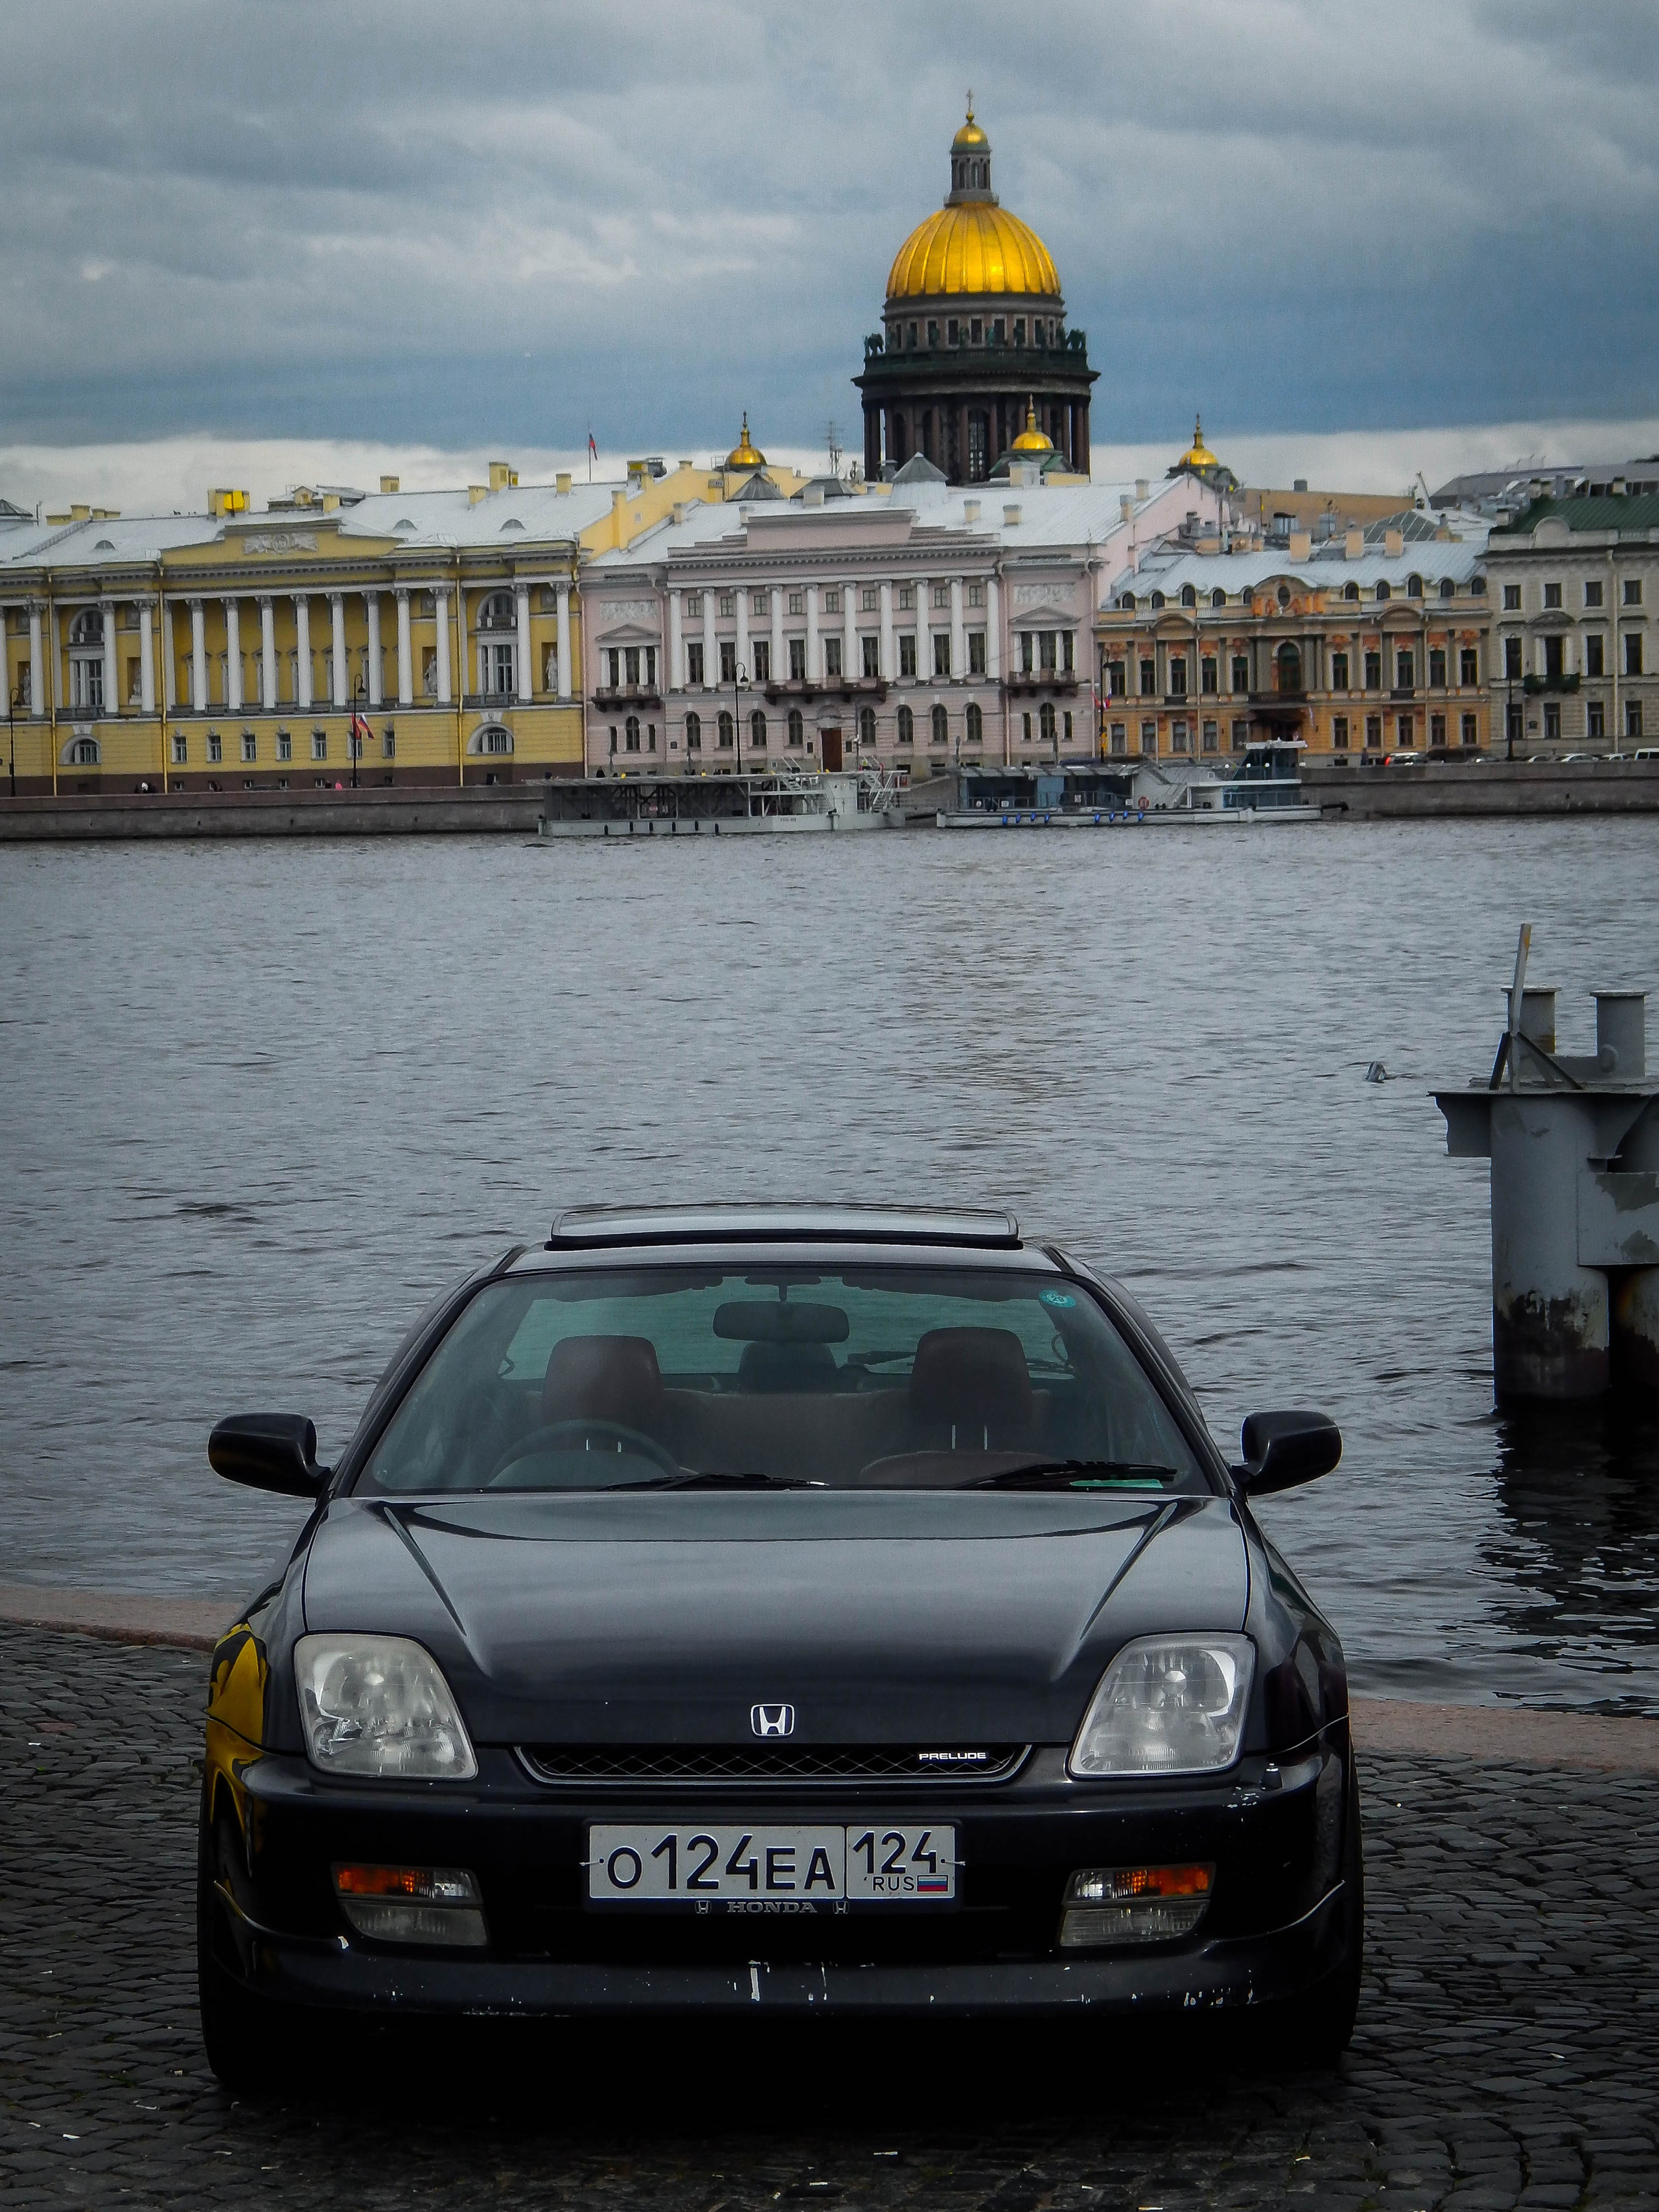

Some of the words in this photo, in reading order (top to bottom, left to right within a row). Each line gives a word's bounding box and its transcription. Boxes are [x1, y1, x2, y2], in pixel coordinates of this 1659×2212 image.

[852, 1830, 938, 1874] 124
[872, 1877, 916, 1891] RUS
[726, 1902, 817, 1913] HONDA
